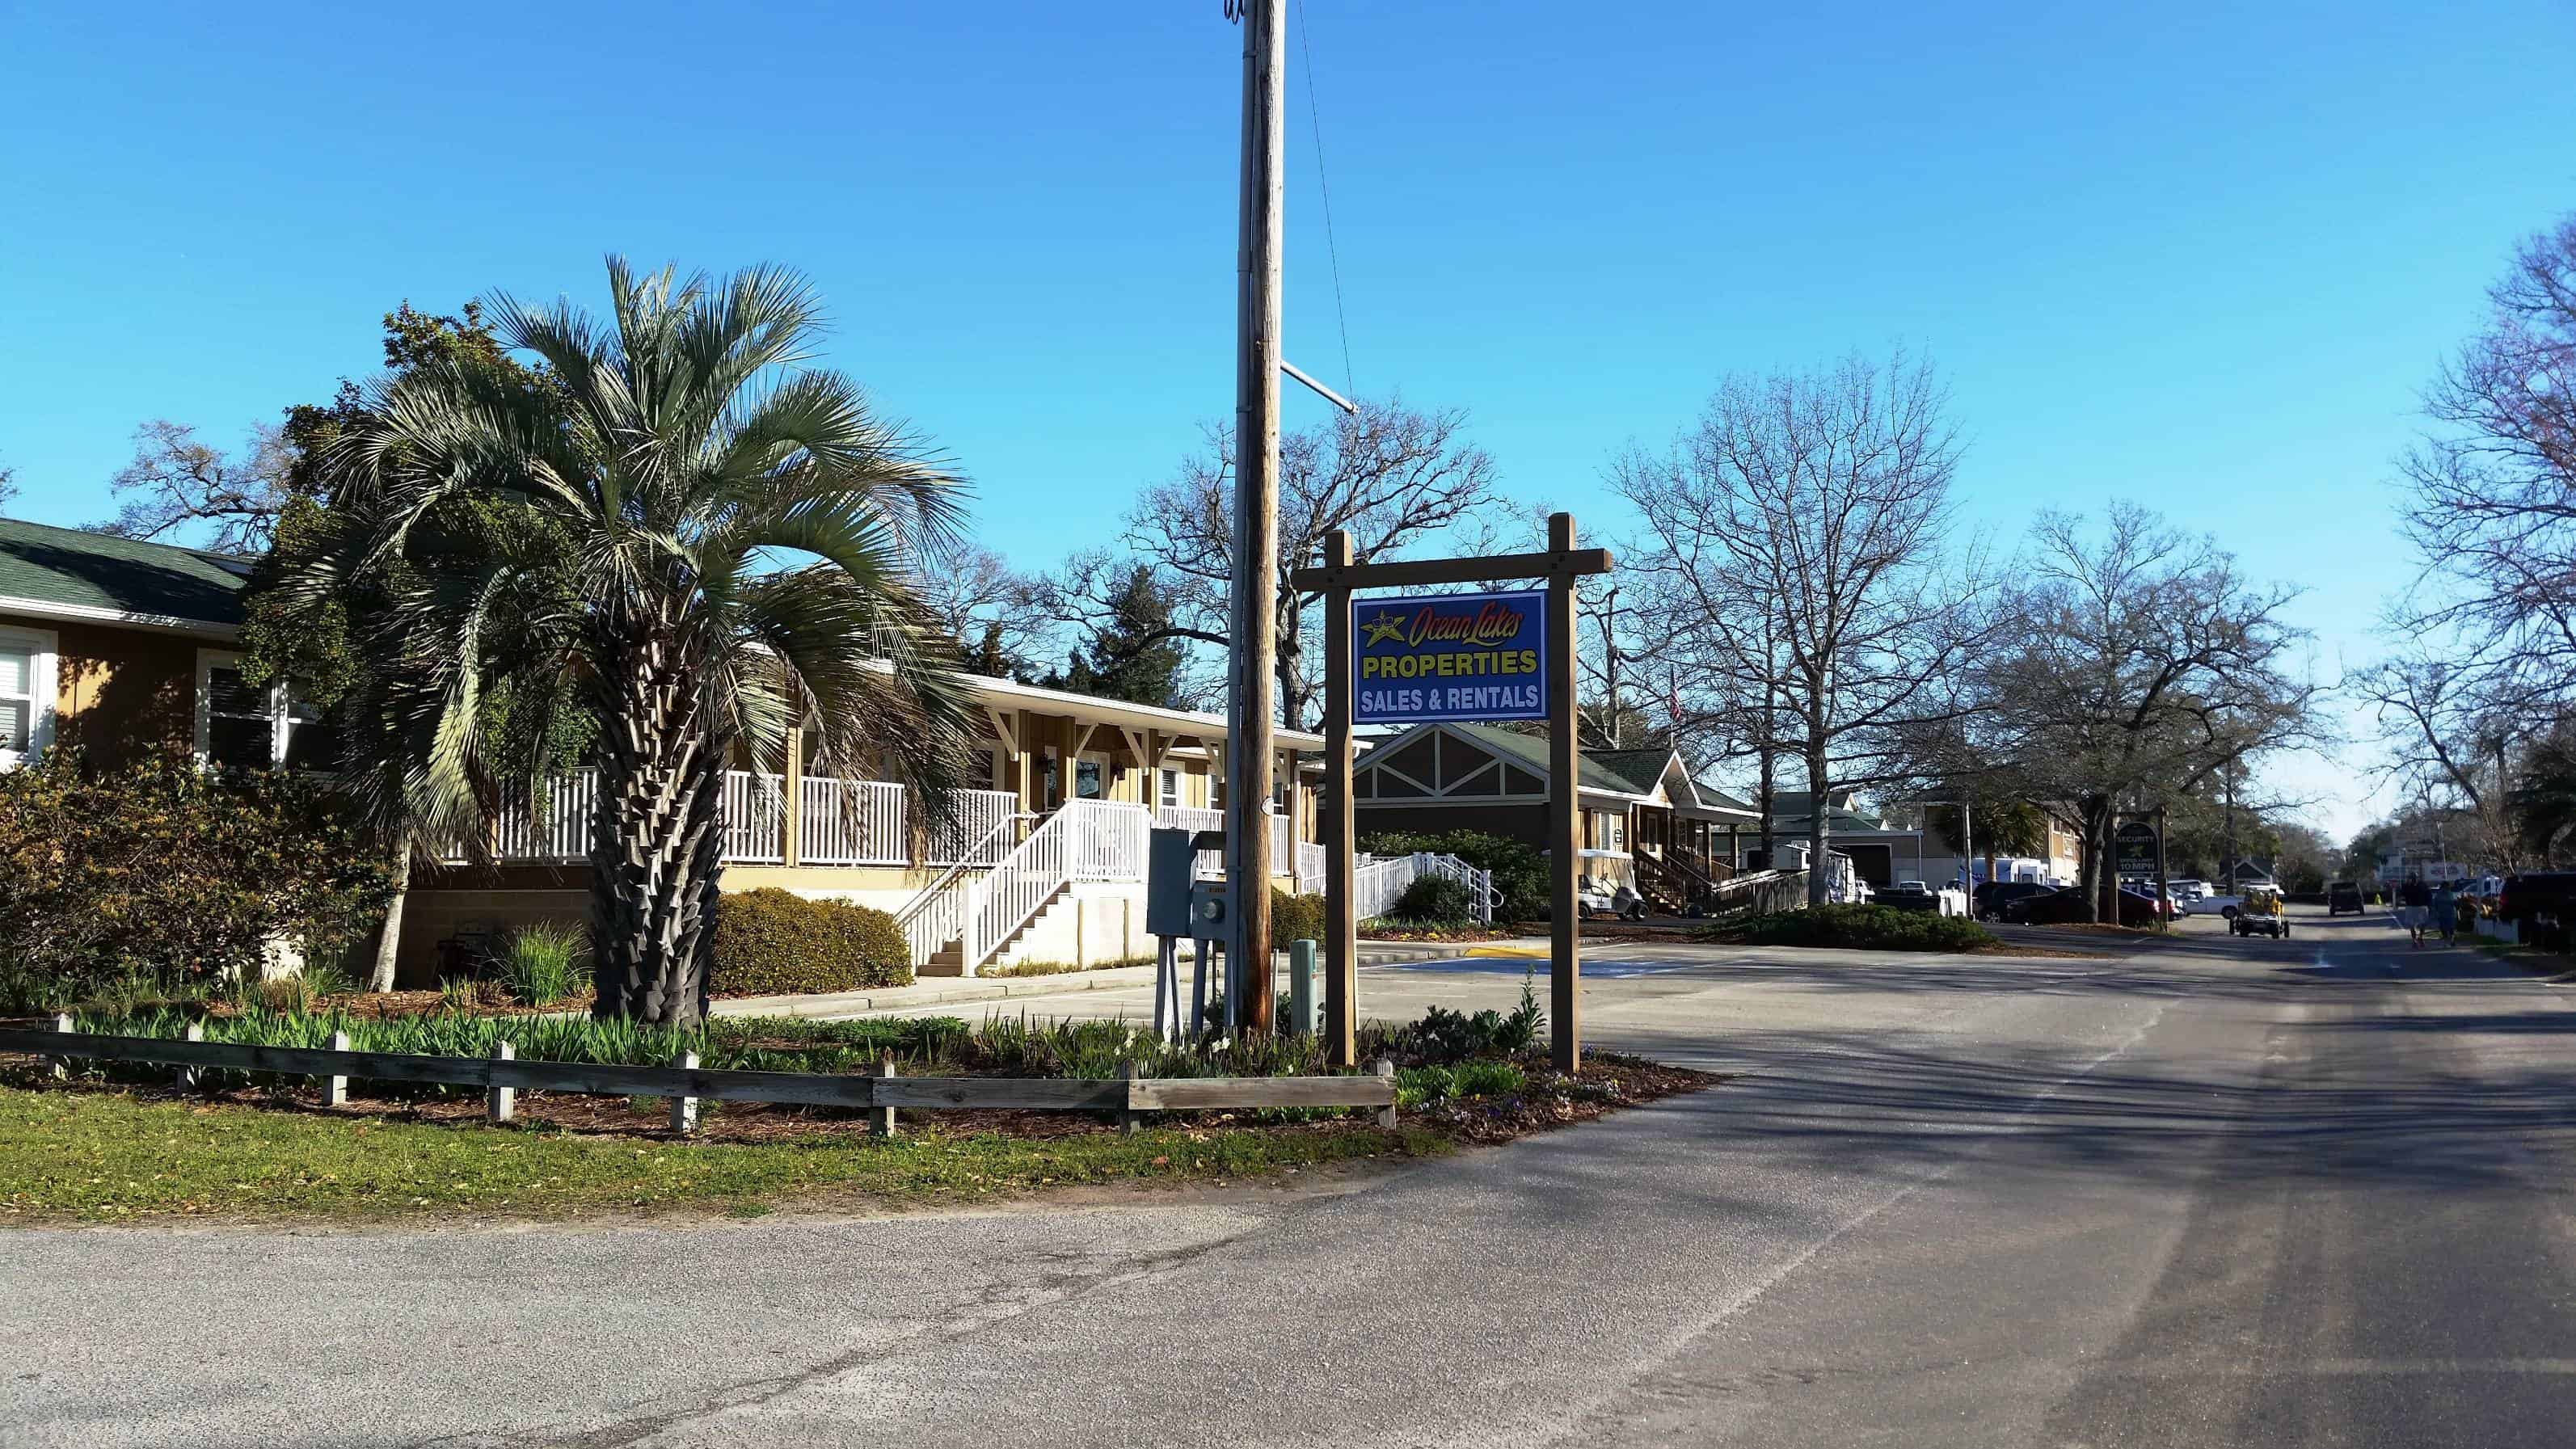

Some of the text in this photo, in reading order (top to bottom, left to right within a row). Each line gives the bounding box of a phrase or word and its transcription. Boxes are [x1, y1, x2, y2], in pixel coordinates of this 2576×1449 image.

[1409, 602, 1524, 647] Ocean Lakes
[1362, 650, 1537, 679] PROPERTIES
[1361, 685, 1538, 713] SALES & RENTALS
